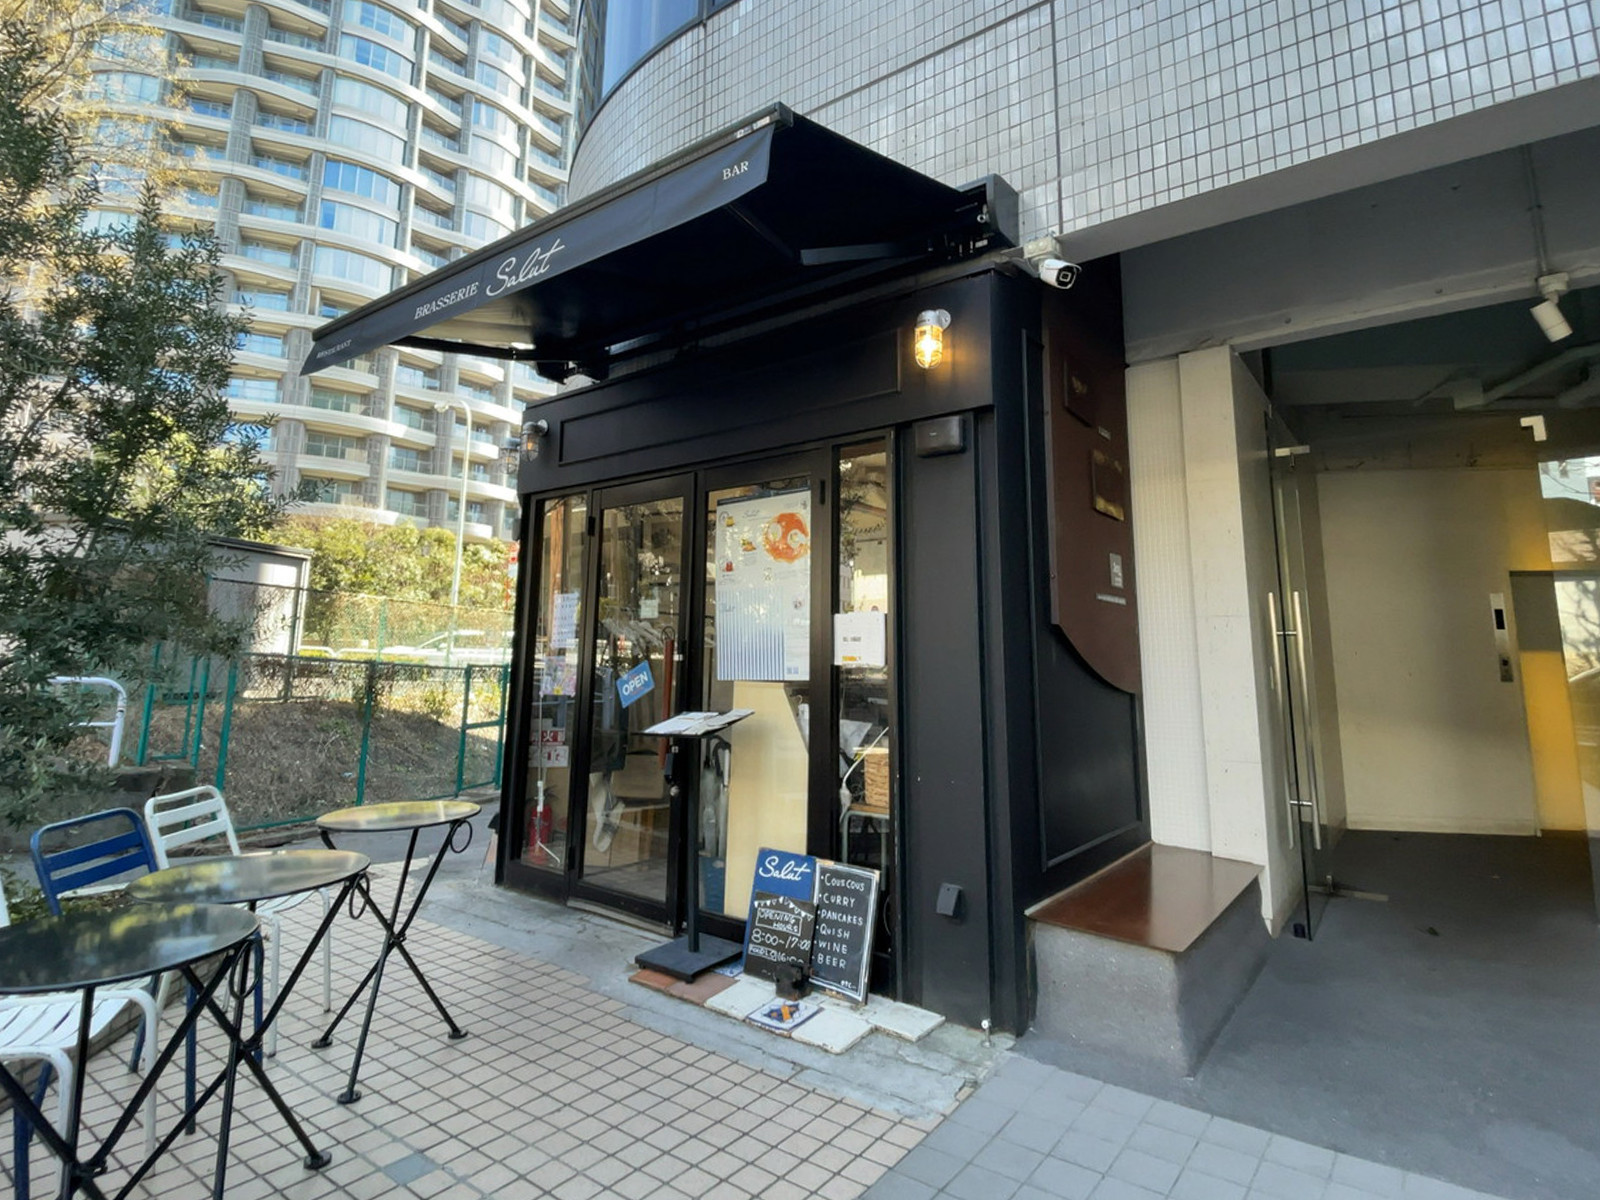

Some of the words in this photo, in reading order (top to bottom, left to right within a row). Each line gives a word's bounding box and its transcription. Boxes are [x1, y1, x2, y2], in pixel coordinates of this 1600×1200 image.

[414, 281, 480, 320] BRASSERIE
[486, 238, 565, 296] Salut
[723, 161, 749, 180] BAR
[622, 671, 648, 696] OPEN
[759, 856, 811, 881] Salut
[821, 909, 863, 926] PANCAKES
[818, 939, 848, 954] WINE
[817, 953, 847, 969] BEER
